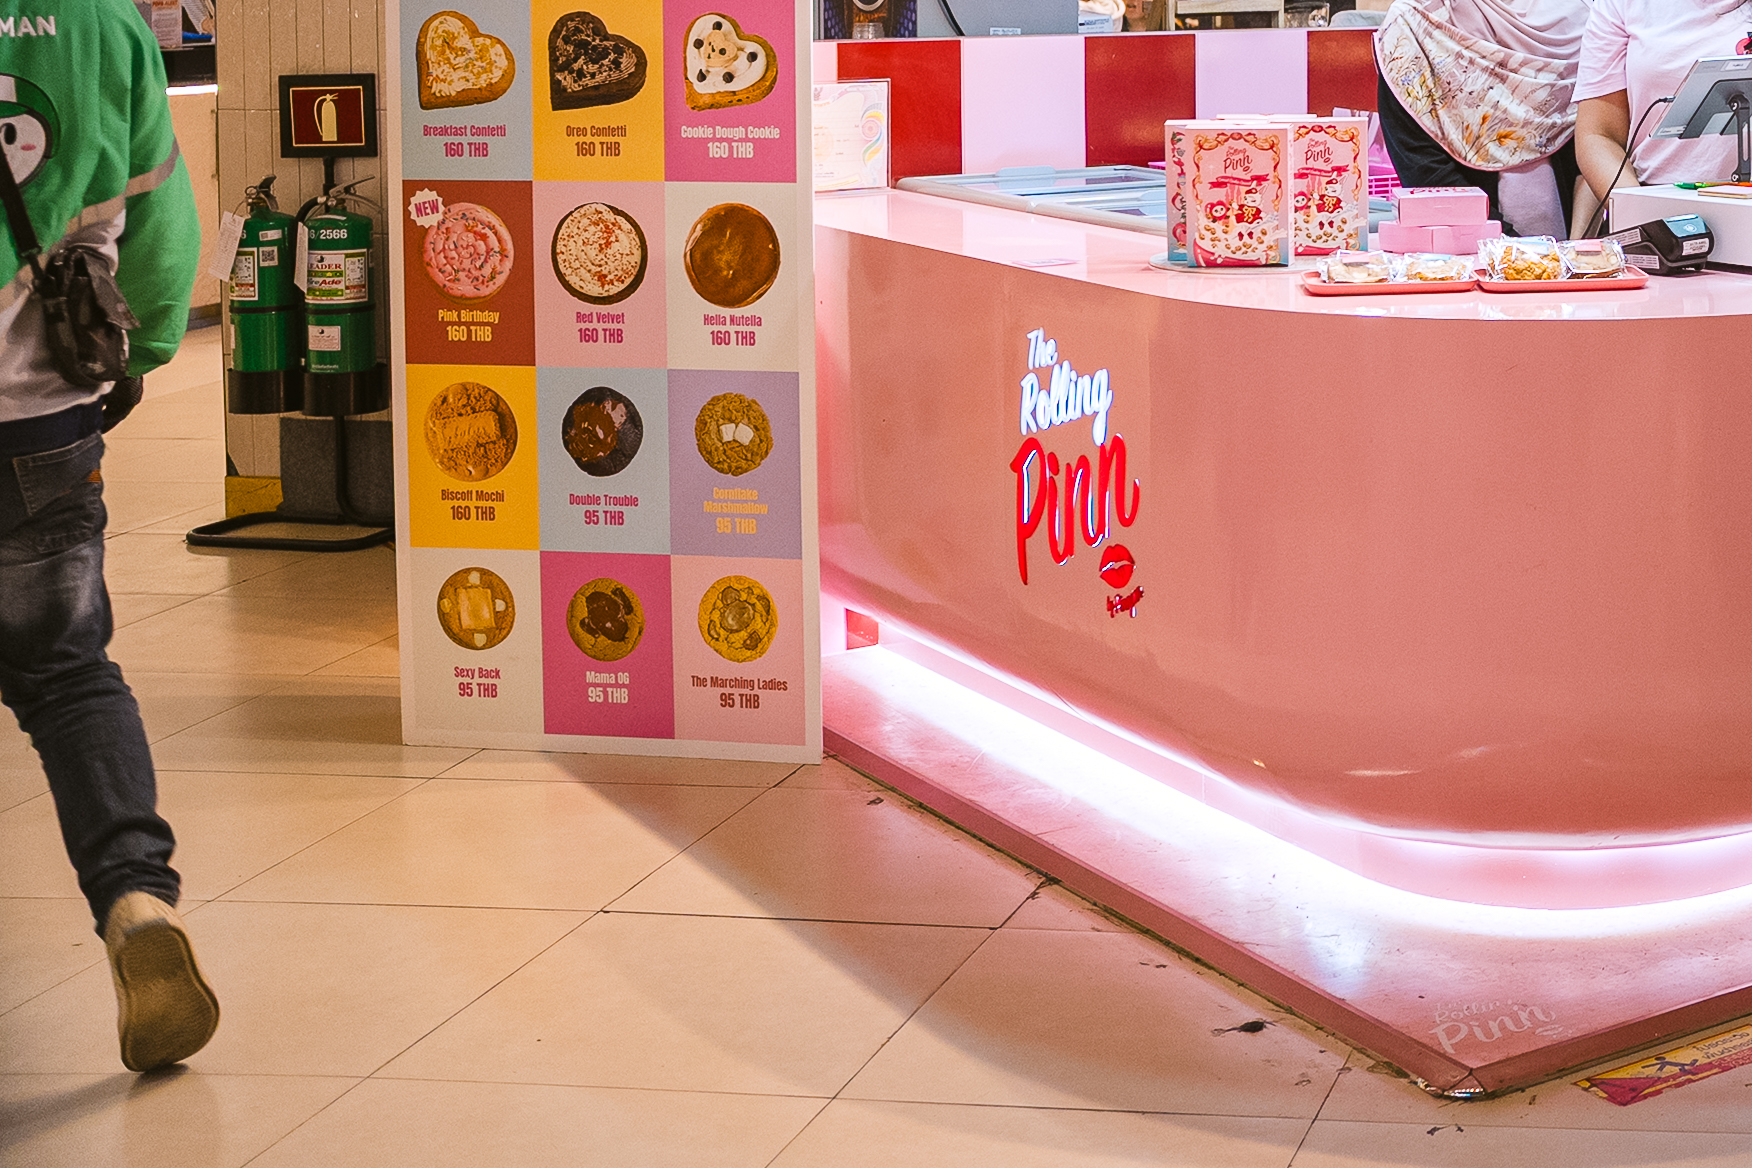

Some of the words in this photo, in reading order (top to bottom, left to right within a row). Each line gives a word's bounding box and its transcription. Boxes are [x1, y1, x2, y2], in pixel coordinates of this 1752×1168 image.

[0, 15, 56, 37] MAN
[423, 125, 468, 138] Breakfast
[470, 125, 506, 137] Confetti
[566, 125, 587, 138] Oreo
[590, 125, 627, 138] Confetti
[681, 126, 712, 139] Cookie
[715, 126, 745, 140] Dough
[747, 126, 780, 139] Cookie
[444, 142, 463, 157] 160
[467, 142, 489, 157] THB
[575, 142, 595, 157] 160
[599, 142, 621, 157] THB
[707, 142, 728, 158] 160
[732, 143, 754, 159] THB
[1304, 146, 1333, 165] Pinn
[1223, 155, 1253, 173] Pinn
[414, 198, 439, 218] NEW
[438, 309, 458, 322] Pink
[461, 309, 500, 325] Birthday
[576, 312, 593, 324] Red
[595, 312, 625, 325] Velvet
[703, 314, 726, 327] Hella
[729, 315, 762, 327] Nutella
[446, 326, 467, 341] 160
[471, 326, 492, 342] THB
[578, 328, 598, 343] 160
[602, 328, 623, 344] THB
[710, 330, 731, 346] 160
[735, 331, 756, 347] THB
[1027, 327, 1058, 370] The
[1020, 360, 1113, 446] Rolling
[441, 489, 474, 502] Biscoff
[476, 489, 505, 502] Mochi
[569, 494, 601, 507] Double
[604, 494, 639, 508] Trouble
[713, 487, 758, 501] Cornflake
[450, 506, 471, 521] 160
[474, 506, 496, 521] THB
[703, 500, 768, 515] Marshmallow
[1009, 433, 1140, 585] Pinn
[584, 510, 600, 526] 95
[603, 510, 625, 526] THB
[716, 518, 732, 534] 95
[735, 518, 757, 534] THB
[454, 666, 475, 680] Sexy
[478, 667, 500, 679] Back
[586, 671, 614, 684] Mama
[615, 672, 630, 685] OG
[458, 682, 473, 698] 95
[477, 682, 498, 698] THB
[691, 675, 708, 688] The
[710, 676, 755, 691] Marching
[757, 678, 788, 691] Ladies
[588, 687, 603, 703] 95
[606, 687, 628, 703] THB
[719, 693, 735, 709] 95
[738, 693, 760, 709] THB
[1428, 1006, 1556, 1054] Pinn
